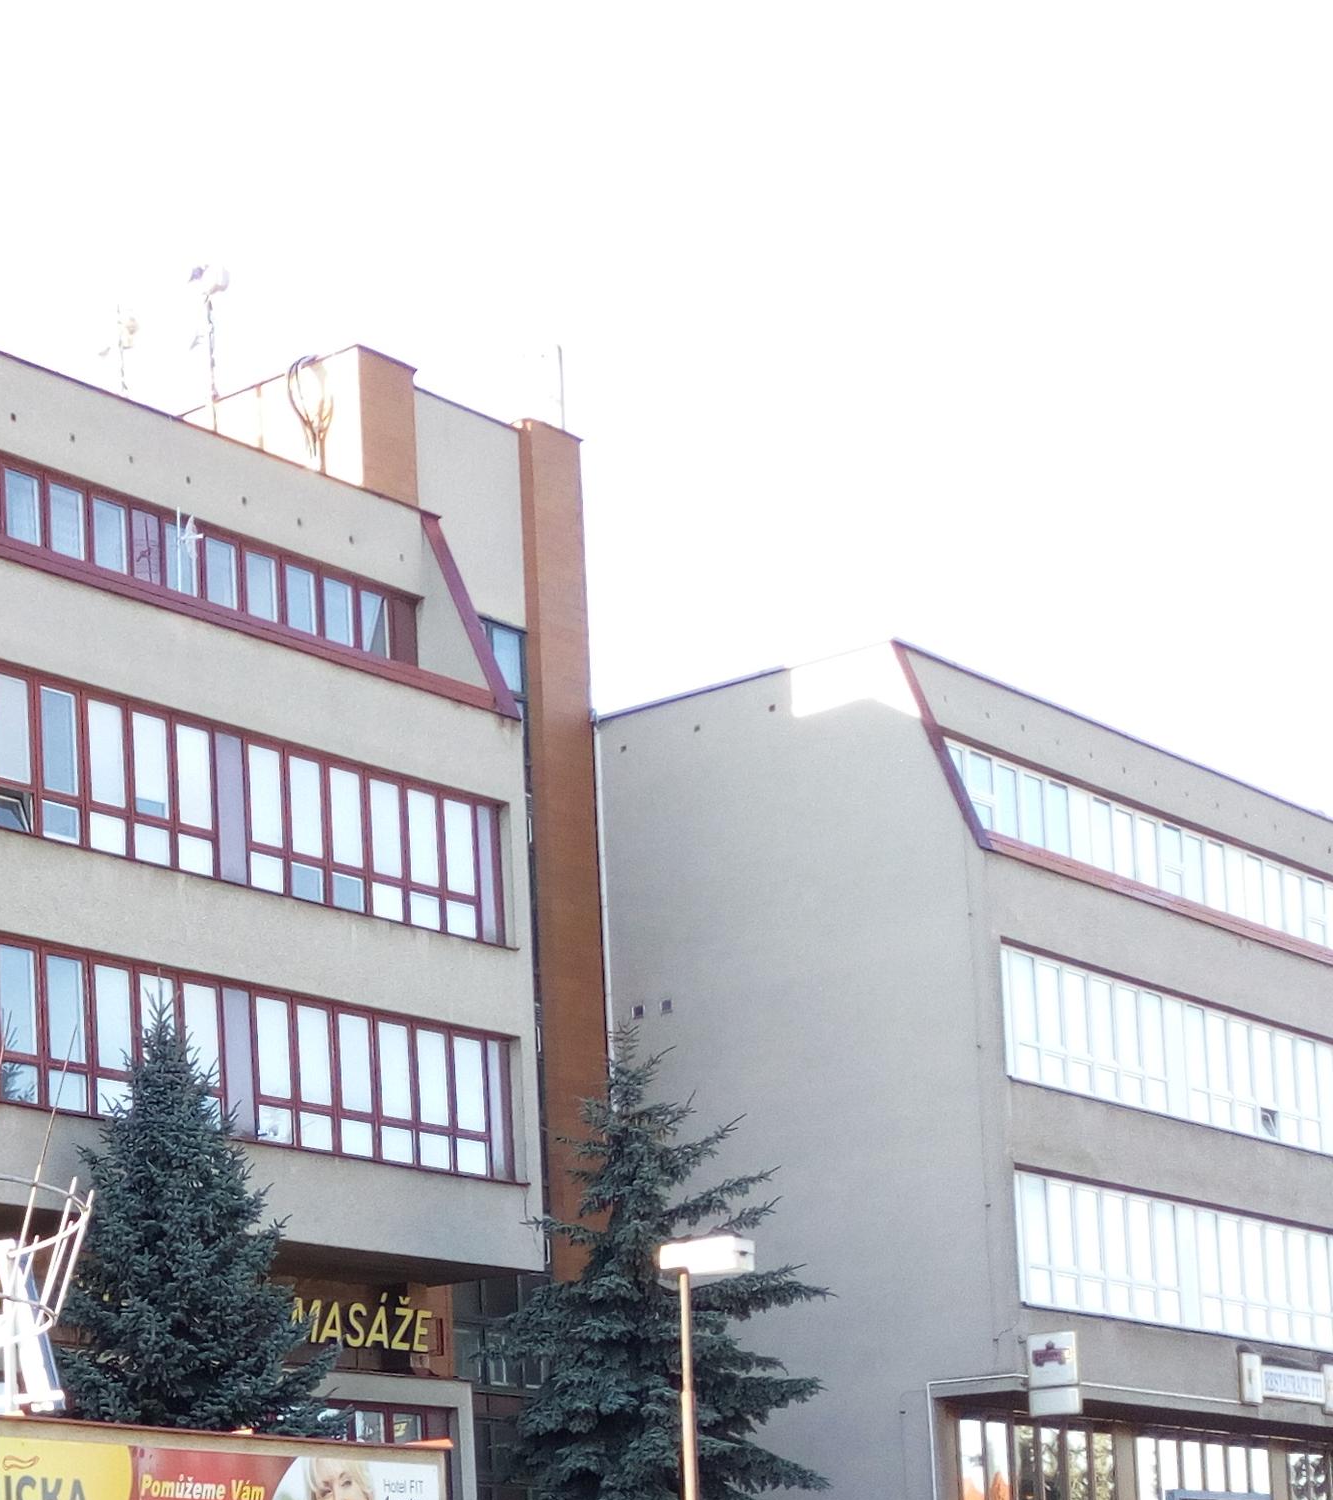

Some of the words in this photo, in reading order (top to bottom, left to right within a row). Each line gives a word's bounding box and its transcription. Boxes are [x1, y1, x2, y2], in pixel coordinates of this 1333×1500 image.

[290, 1291, 433, 1353] MASÁŽE
[140, 1473, 226, 1500] Pomůžeme
[409, 1479, 424, 1494] FIT
